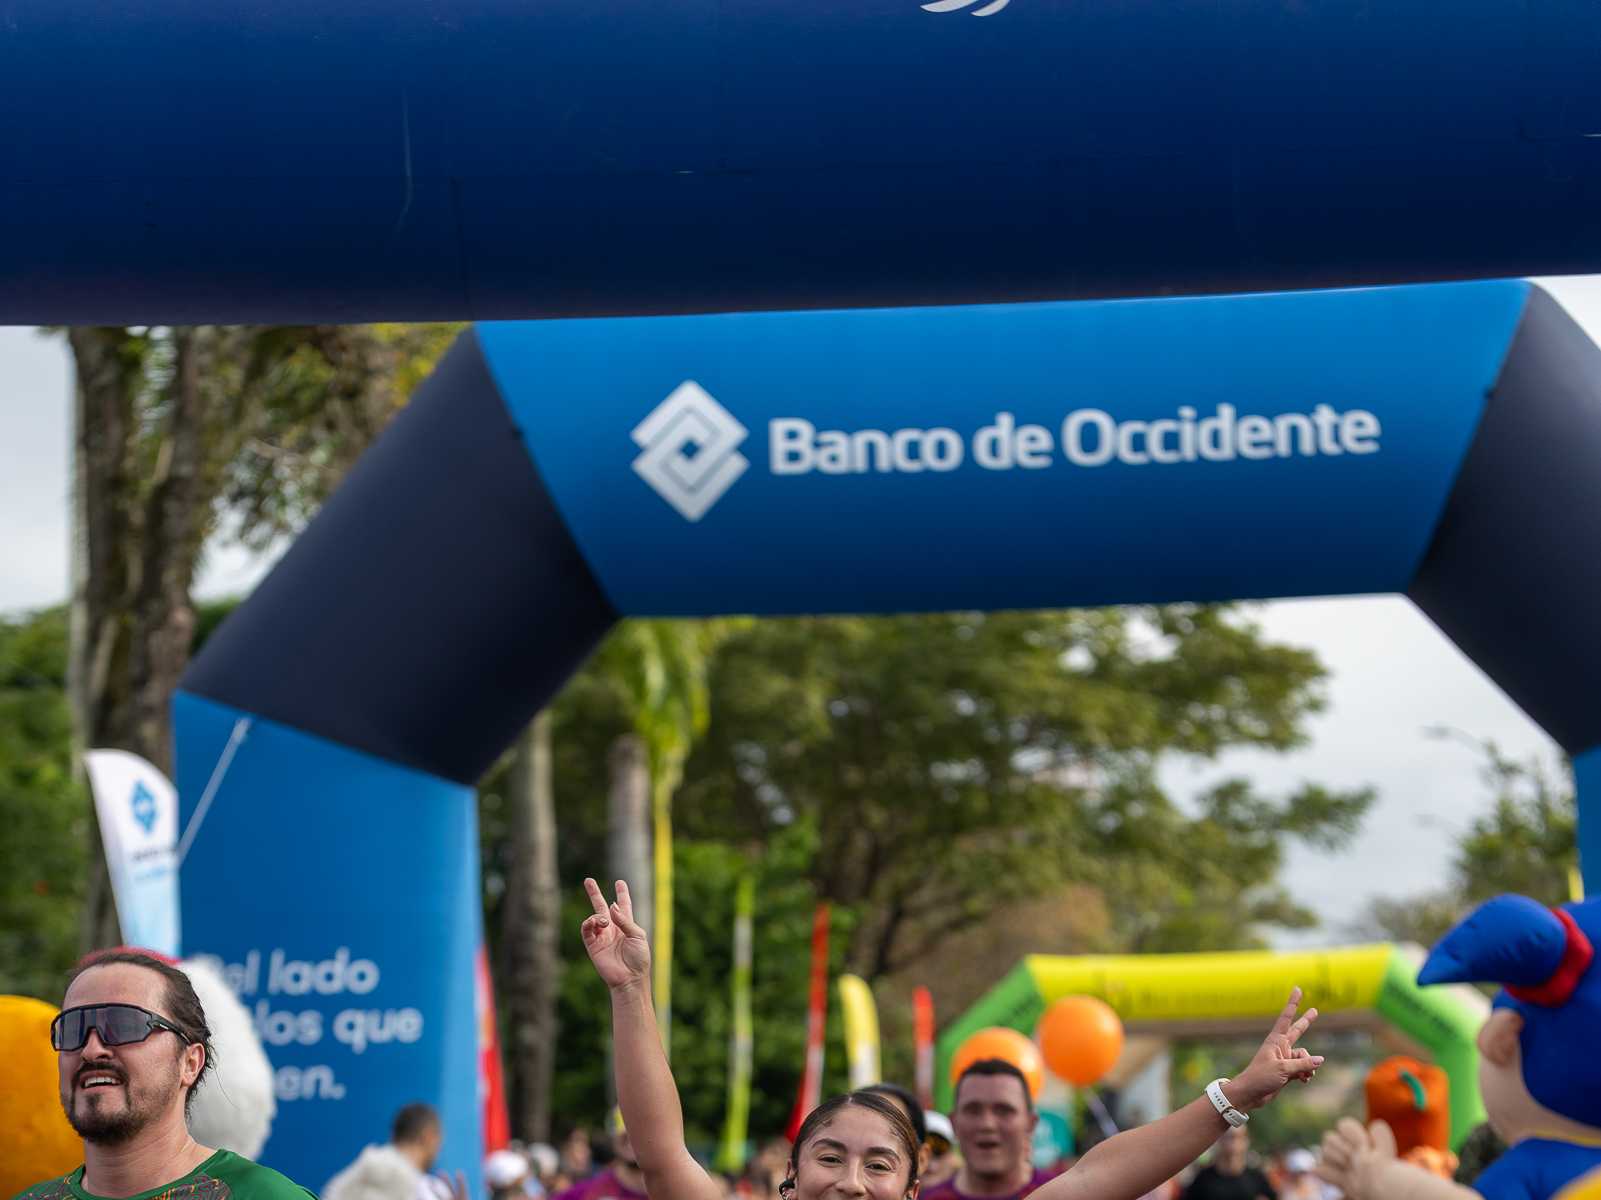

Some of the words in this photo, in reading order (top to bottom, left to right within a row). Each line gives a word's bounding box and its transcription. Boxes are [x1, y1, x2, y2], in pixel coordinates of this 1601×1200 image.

[768, 417, 963, 475] Banco
[974, 411, 1053, 471] de
[1061, 402, 1382, 467] Occidente
[268, 946, 380, 996] lado
[255, 998, 324, 1046] los
[332, 1007, 424, 1054] que
